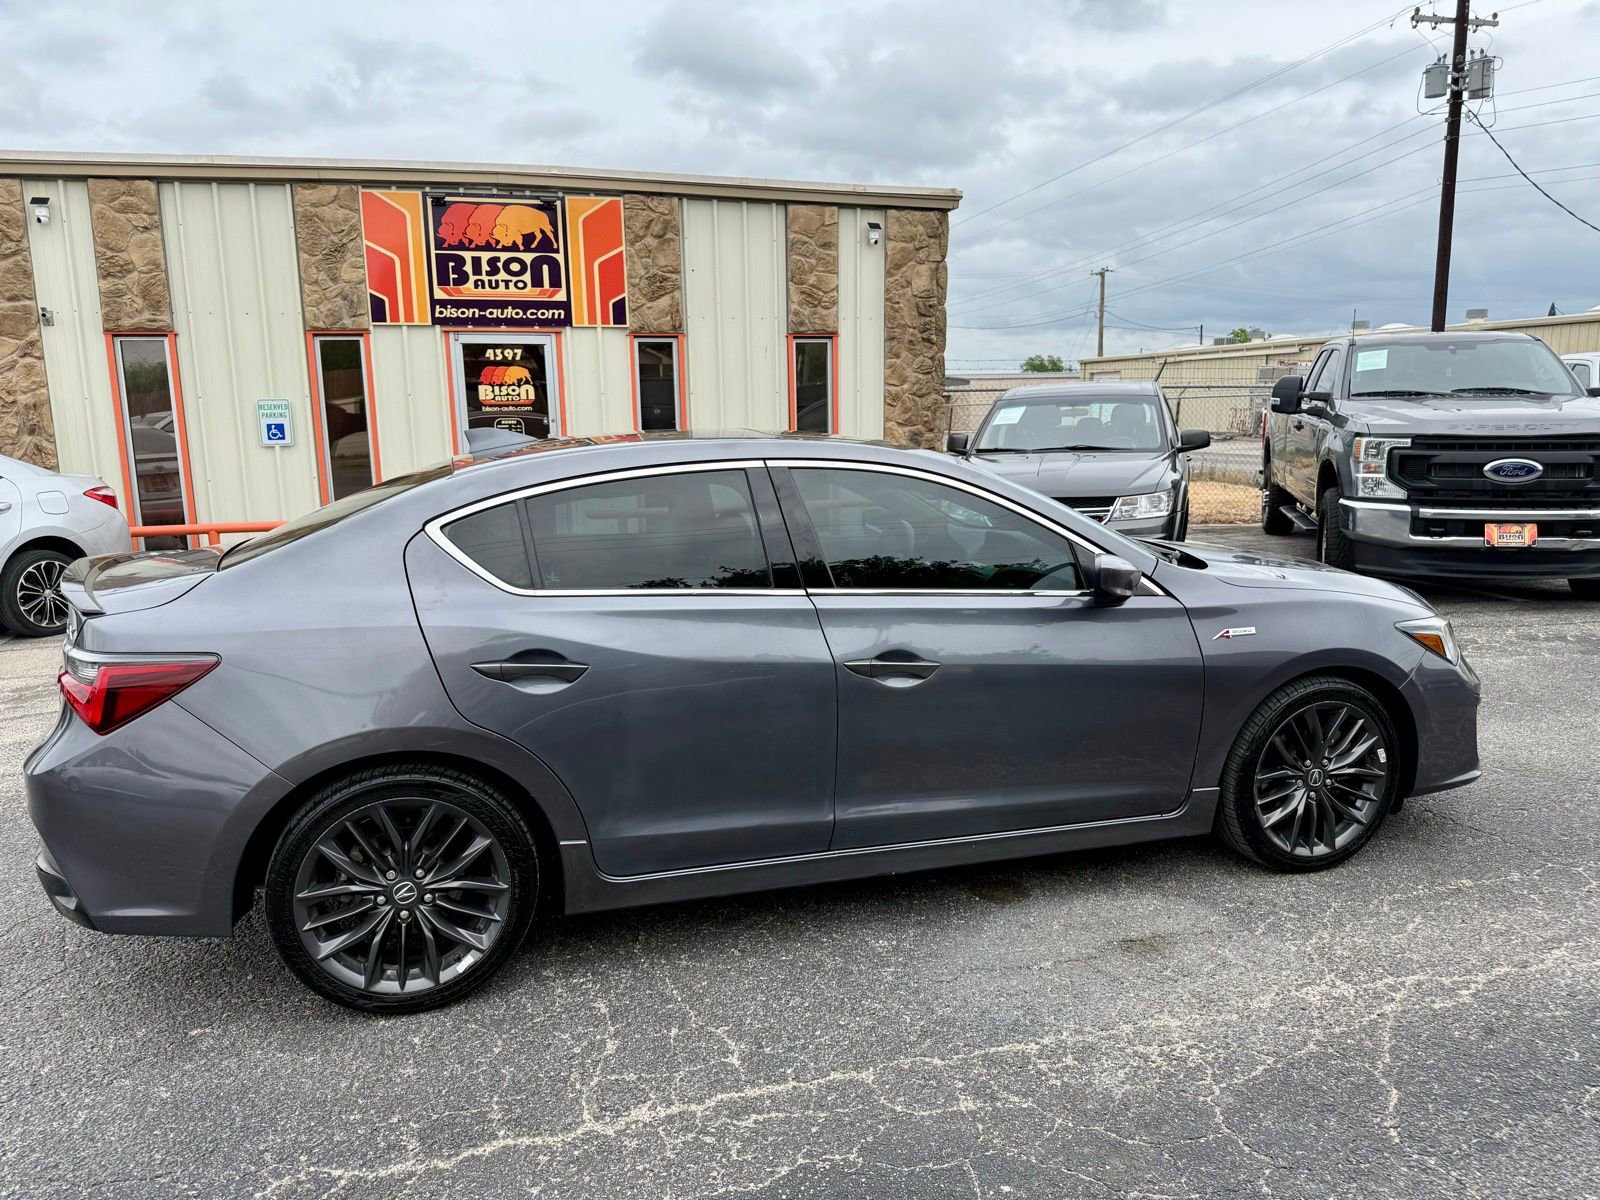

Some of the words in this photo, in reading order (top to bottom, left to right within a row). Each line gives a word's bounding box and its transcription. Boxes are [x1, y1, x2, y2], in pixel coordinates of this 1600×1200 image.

[435, 253, 562, 288] BISON
[474, 279, 527, 290] AUTO
[435, 305, 565, 319] bison-auto.com
[478, 384, 535, 400] BISON
[1500, 464, 1528, 476] Ford
